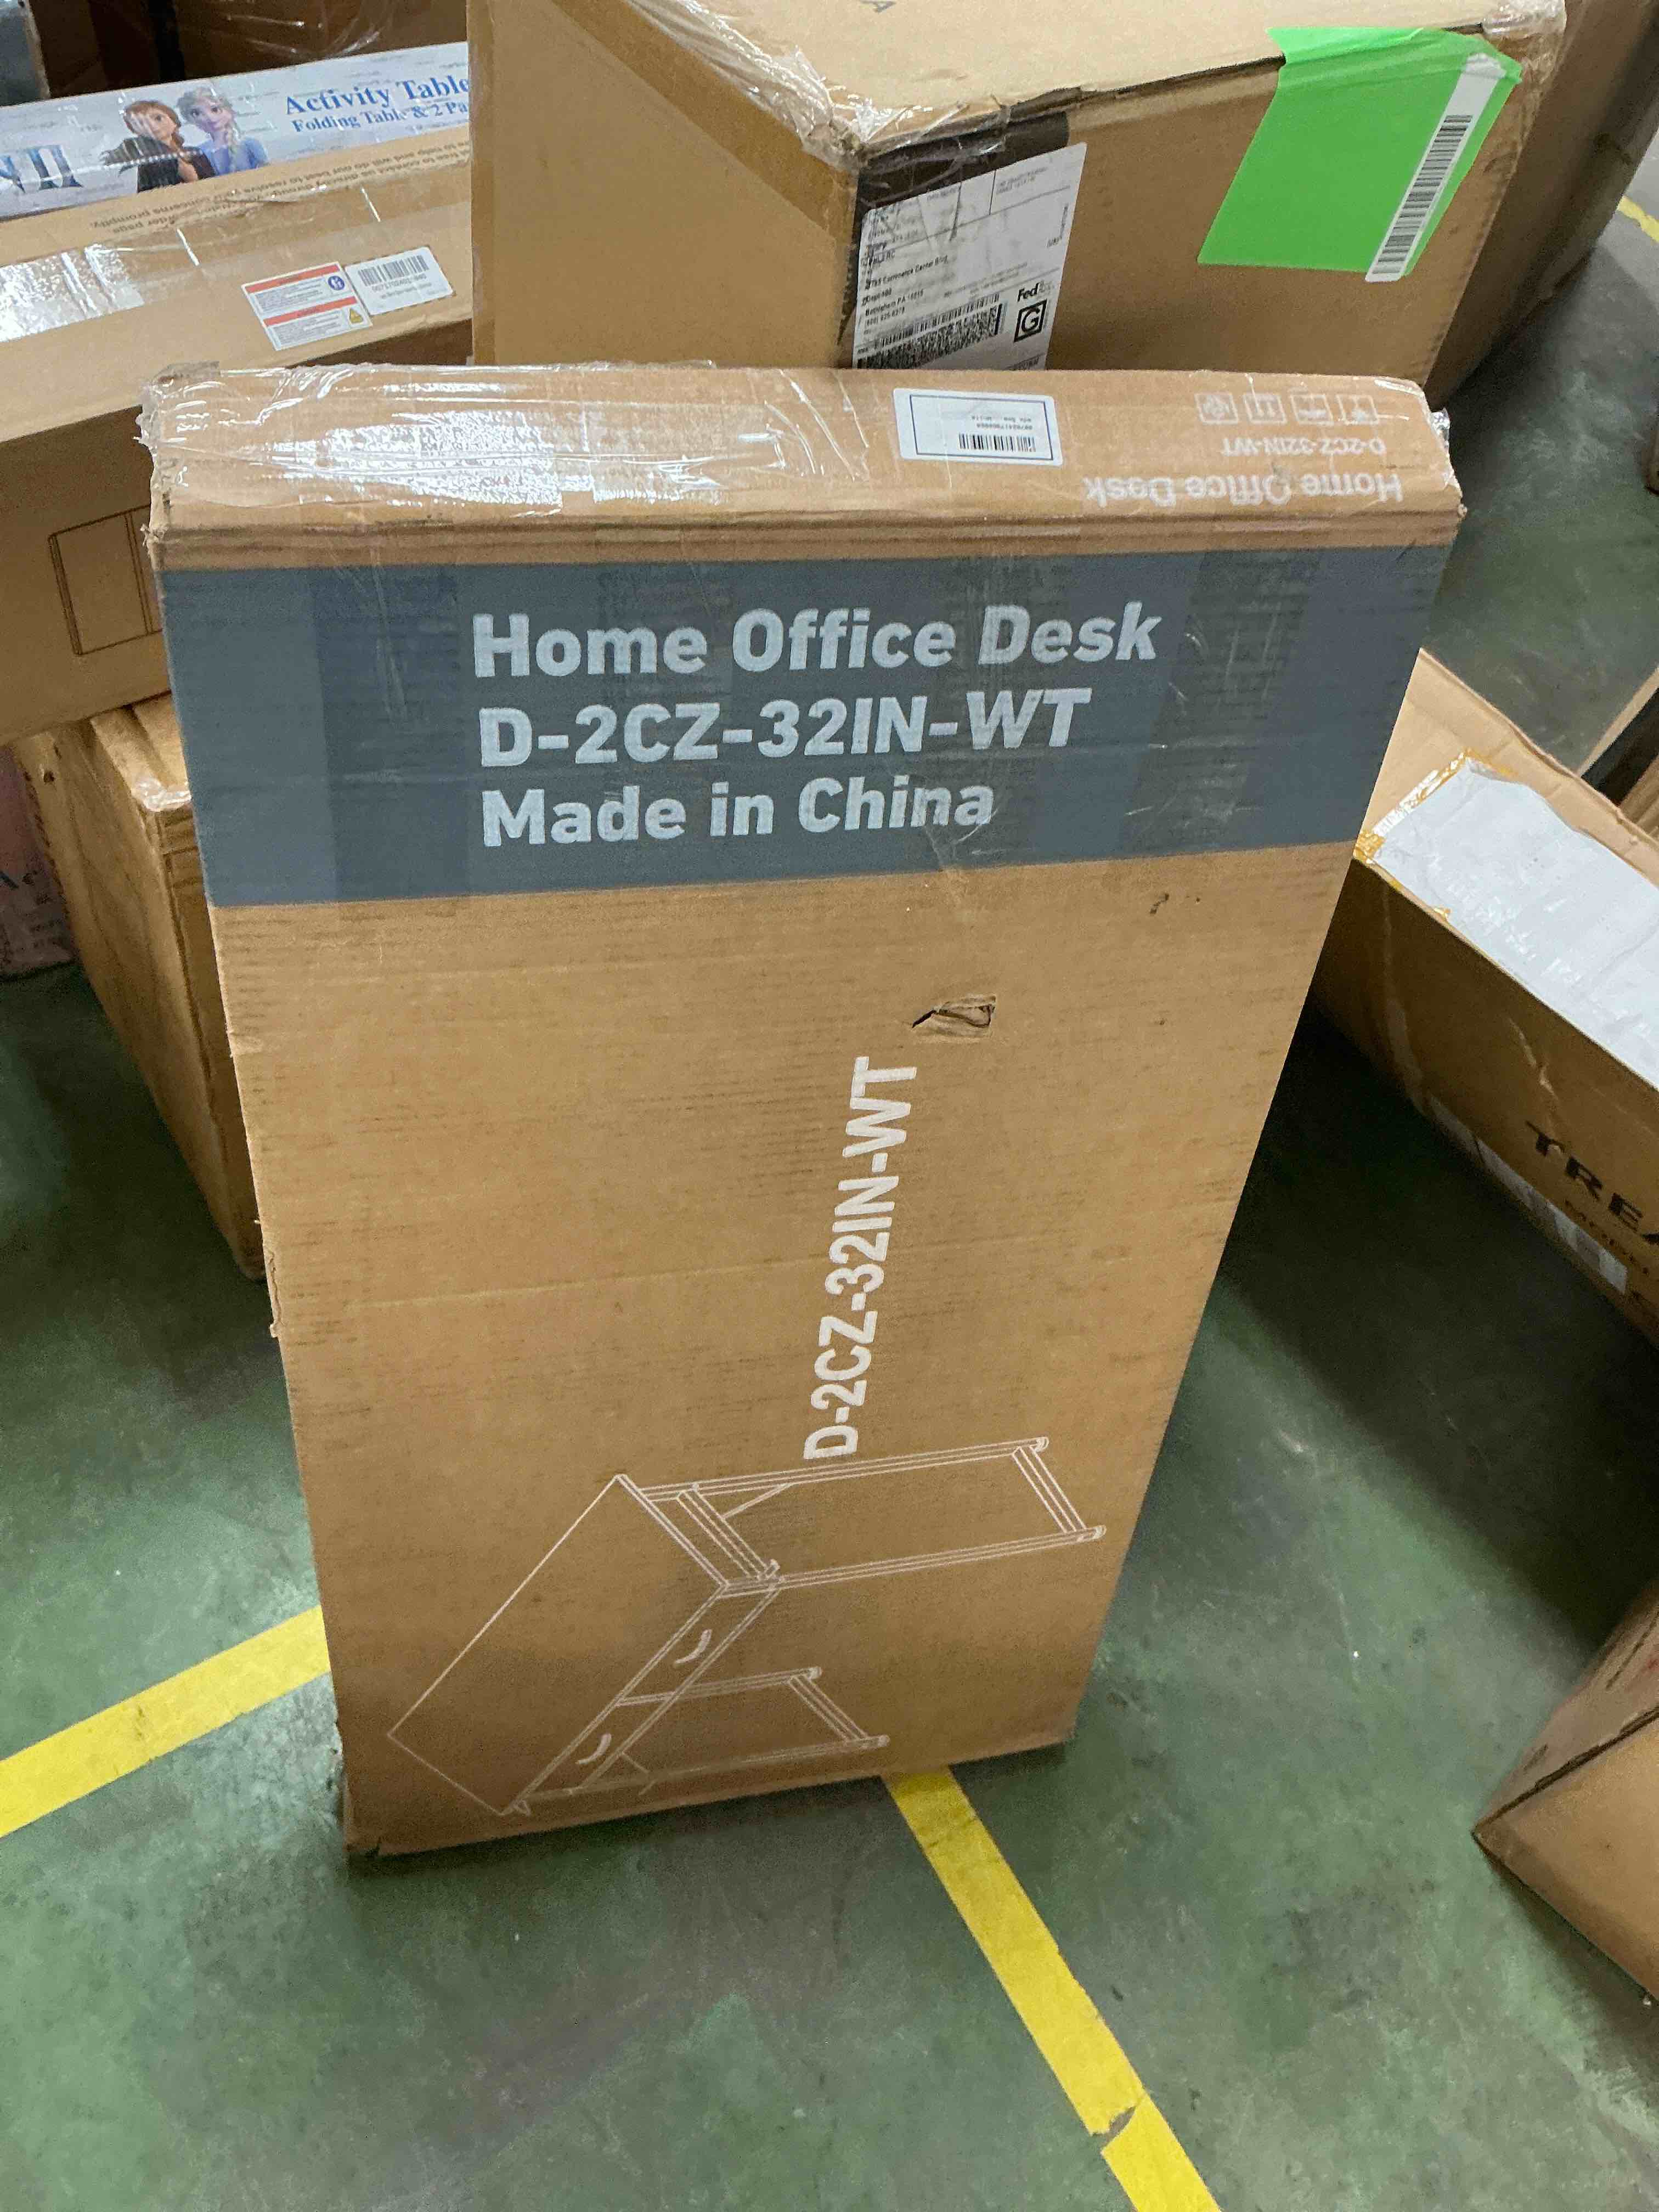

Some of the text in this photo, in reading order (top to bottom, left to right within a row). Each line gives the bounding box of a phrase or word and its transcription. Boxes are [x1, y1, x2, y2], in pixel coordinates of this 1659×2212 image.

[286, 86, 390, 115] Activity
[292, 114, 360, 133] Folding
[360, 108, 408, 125] Table
[413, 105, 429, 119] &
[433, 104, 443, 116] 2
[1221, 437, 1386, 458] D-2CZ-32IN-WT
[1082, 471, 1404, 509] Home Office Desk
[472, 601, 1163, 678] Home Office Desk
[478, 687, 1093, 767] D-2CZ-32IN-WT
[482, 774, 994, 847] Made in China
[803, 1056, 918, 1460] D-2CZ-32IN-WT
